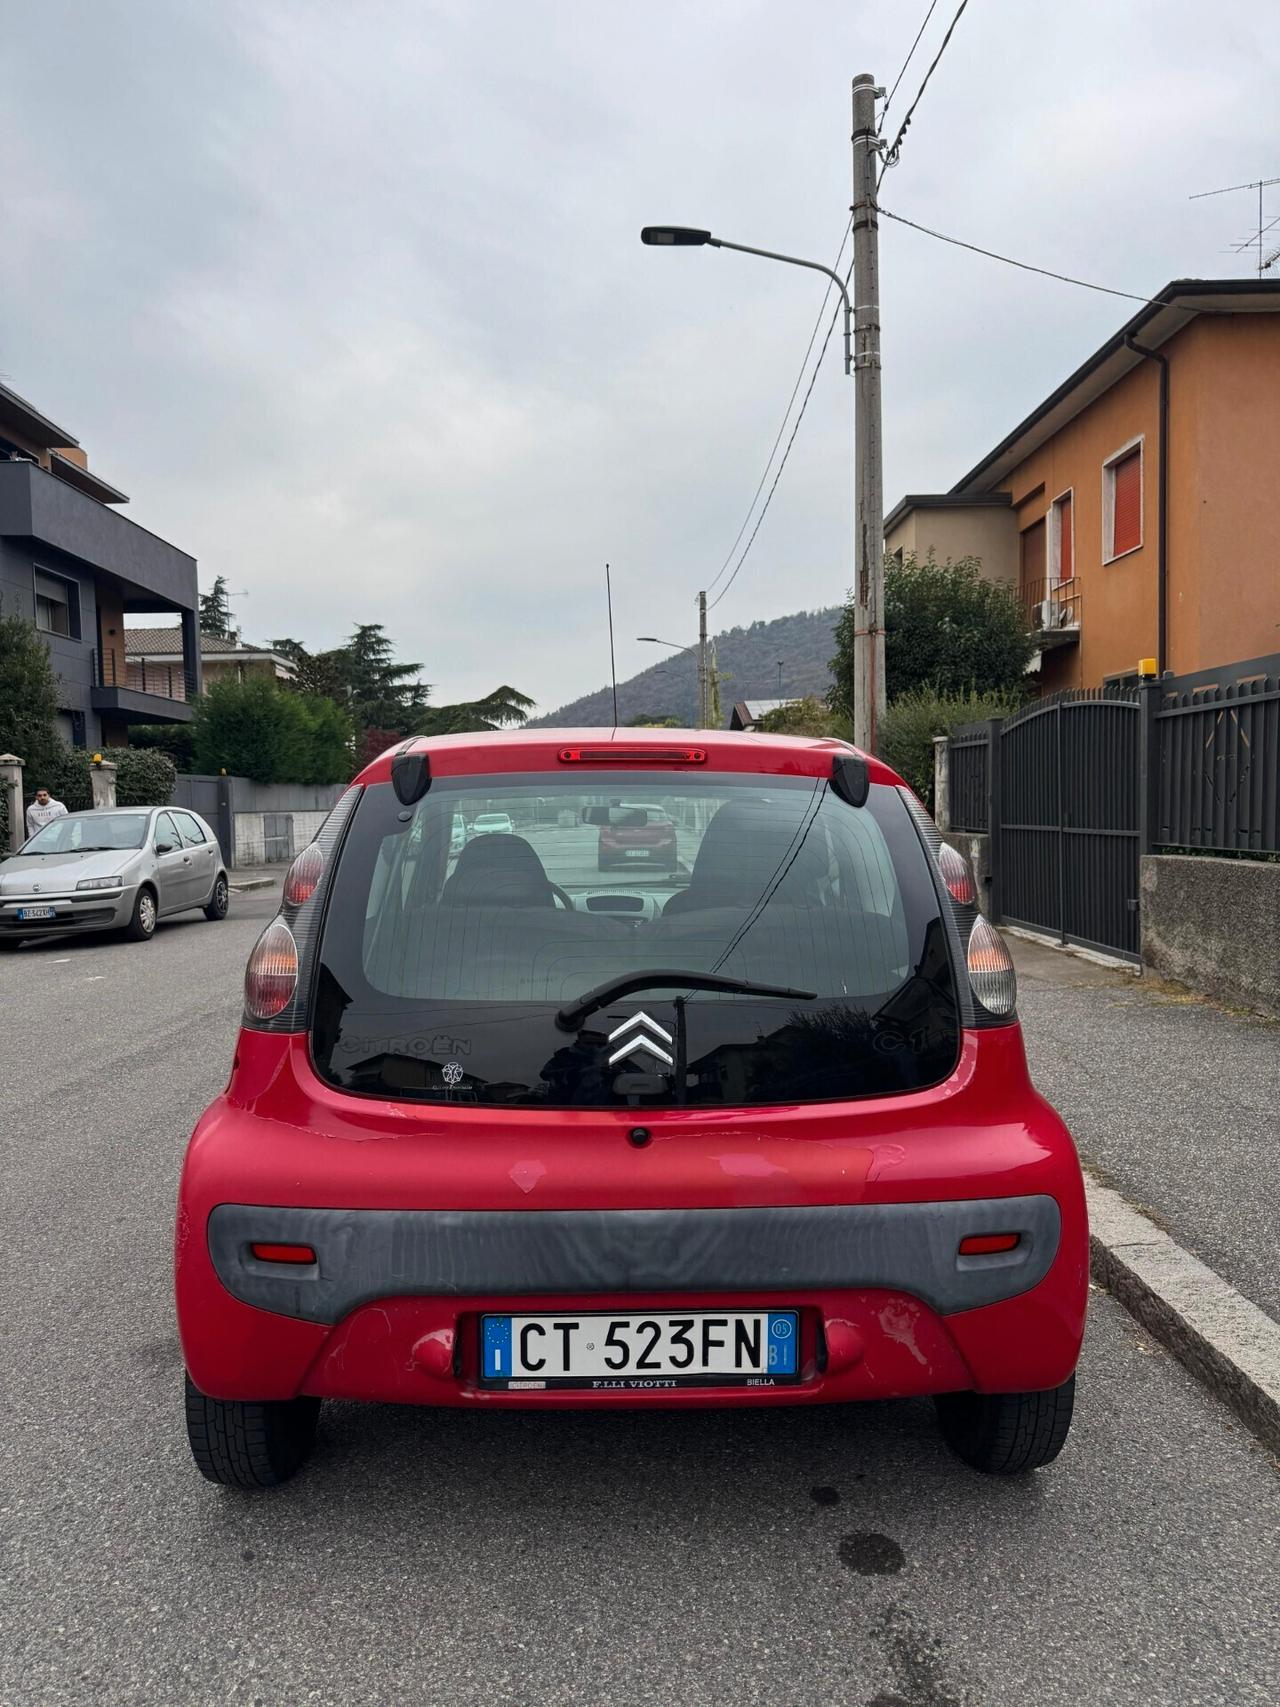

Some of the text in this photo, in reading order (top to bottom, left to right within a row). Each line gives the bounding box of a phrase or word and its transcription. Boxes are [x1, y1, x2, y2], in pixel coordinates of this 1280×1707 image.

[775, 1323, 788, 1335] 05
[520, 1318, 762, 1372] CT 523FN
[768, 1344, 788, 1366] BI
[592, 1379, 677, 1388] F.LLI VIOTTI
[746, 1378, 776, 1386] BIELLA
